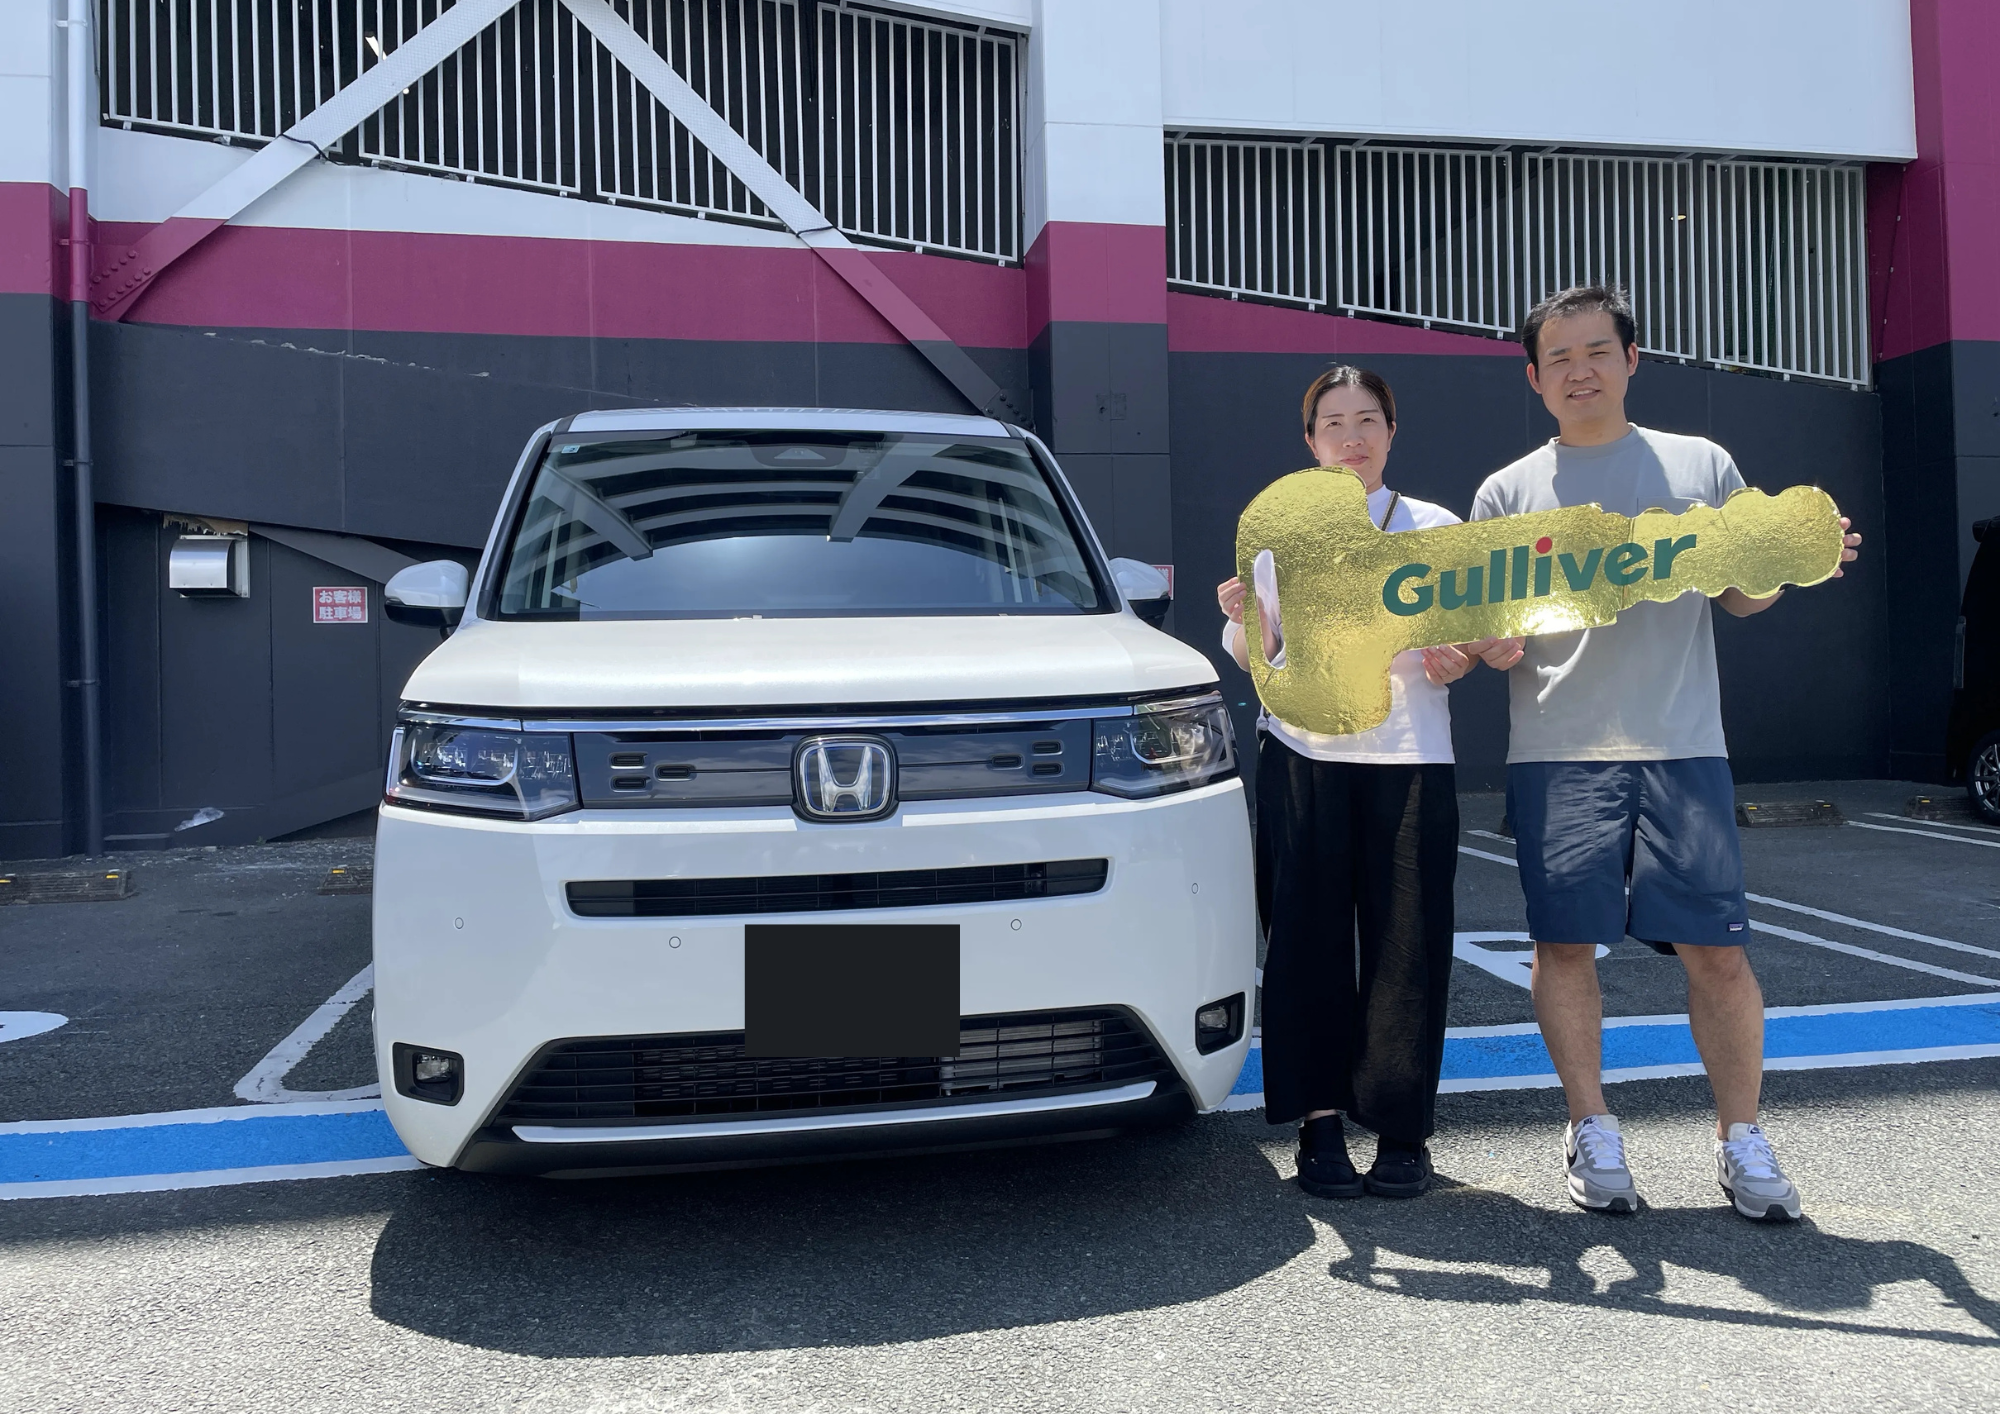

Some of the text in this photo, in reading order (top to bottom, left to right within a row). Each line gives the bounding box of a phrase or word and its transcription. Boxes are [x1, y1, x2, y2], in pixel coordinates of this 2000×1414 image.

[1382, 533, 1697, 616] Gulliver
[318, 589, 362, 604] お客様
[318, 605, 362, 620] 駐車場
